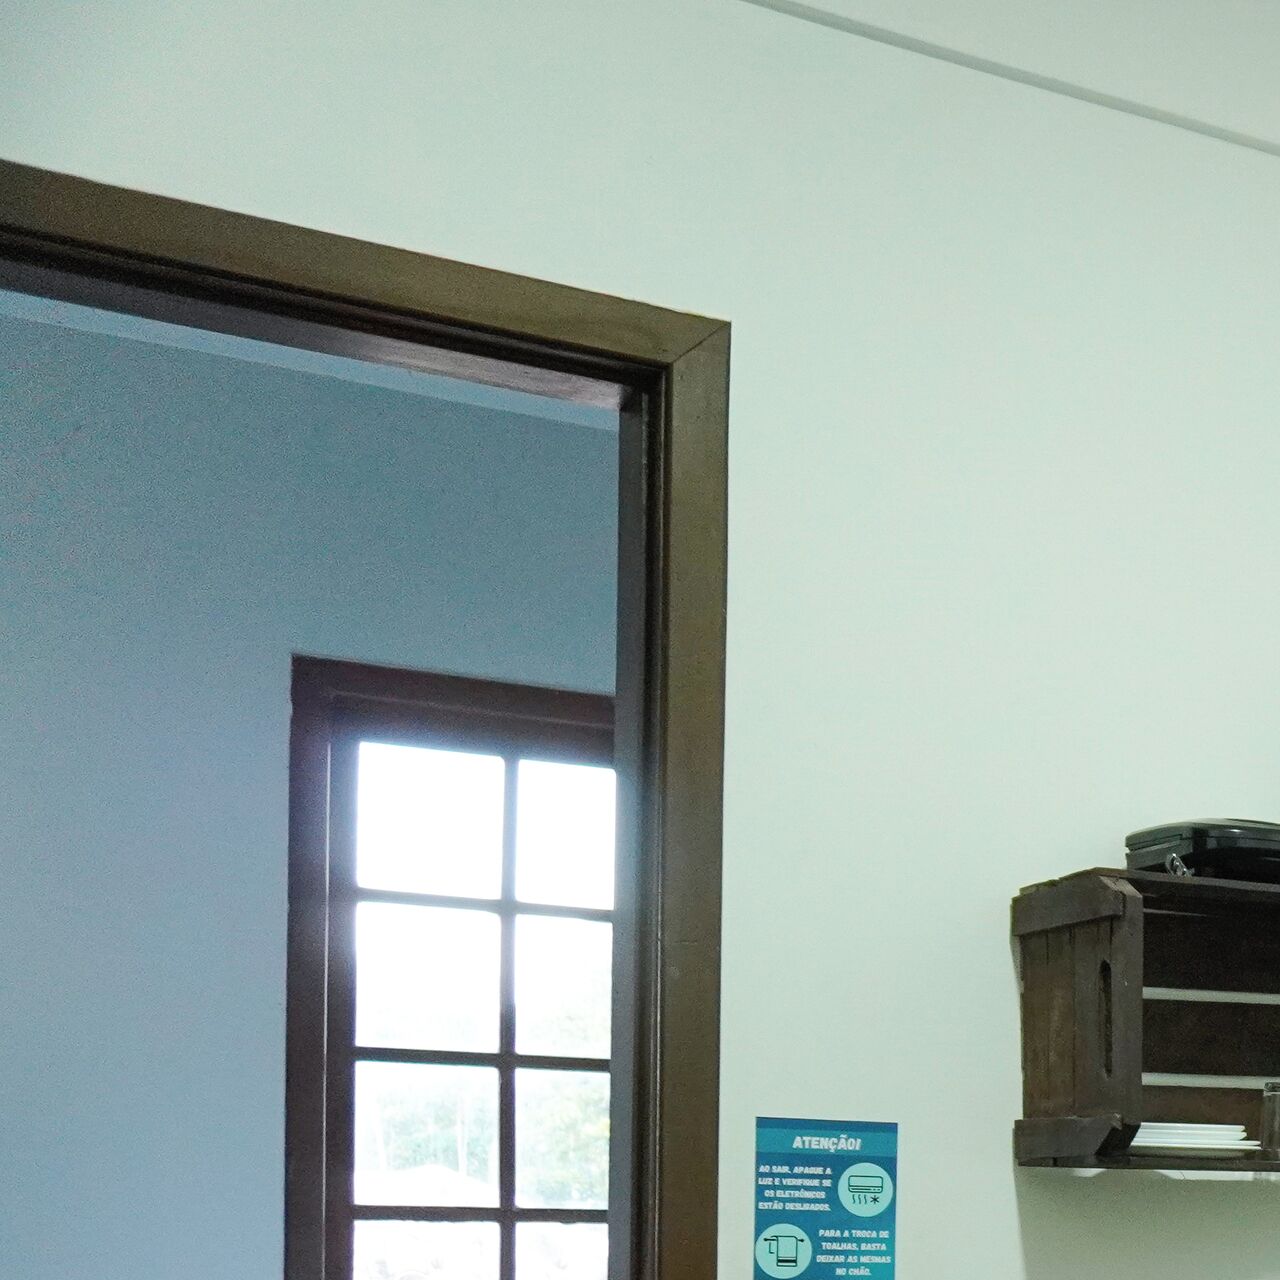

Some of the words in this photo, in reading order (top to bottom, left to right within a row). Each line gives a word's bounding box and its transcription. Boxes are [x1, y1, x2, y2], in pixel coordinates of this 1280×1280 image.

[792, 1134, 862, 1153] ATENÇÃO!
[758, 1165, 770, 1173] AO
[792, 1166, 824, 1175] APAGUE
[824, 1167, 833, 1175] A
[758, 1177, 773, 1185] LUZ
[774, 1177, 780, 1185] E
[782, 1178, 820, 1187] VERIFIQUE
[822, 1178, 832, 1187] SE
[764, 1189, 775, 1198] OS
[775, 1188, 826, 1199] ELETRÔNICOS
[758, 1200, 784, 1209] ESTÃO
[818, 1229, 841, 1238] PARA
[842, 1230, 850, 1238] A
[851, 1230, 877, 1238] TROCA
[879, 1230, 889, 1238] DE
[860, 1242, 887, 1251] BASTA
[816, 1254, 845, 1263] DEIXAR
[846, 1255, 858, 1263] AS
[859, 1255, 892, 1264] MESMAS
[835, 1267, 847, 1276] NO
